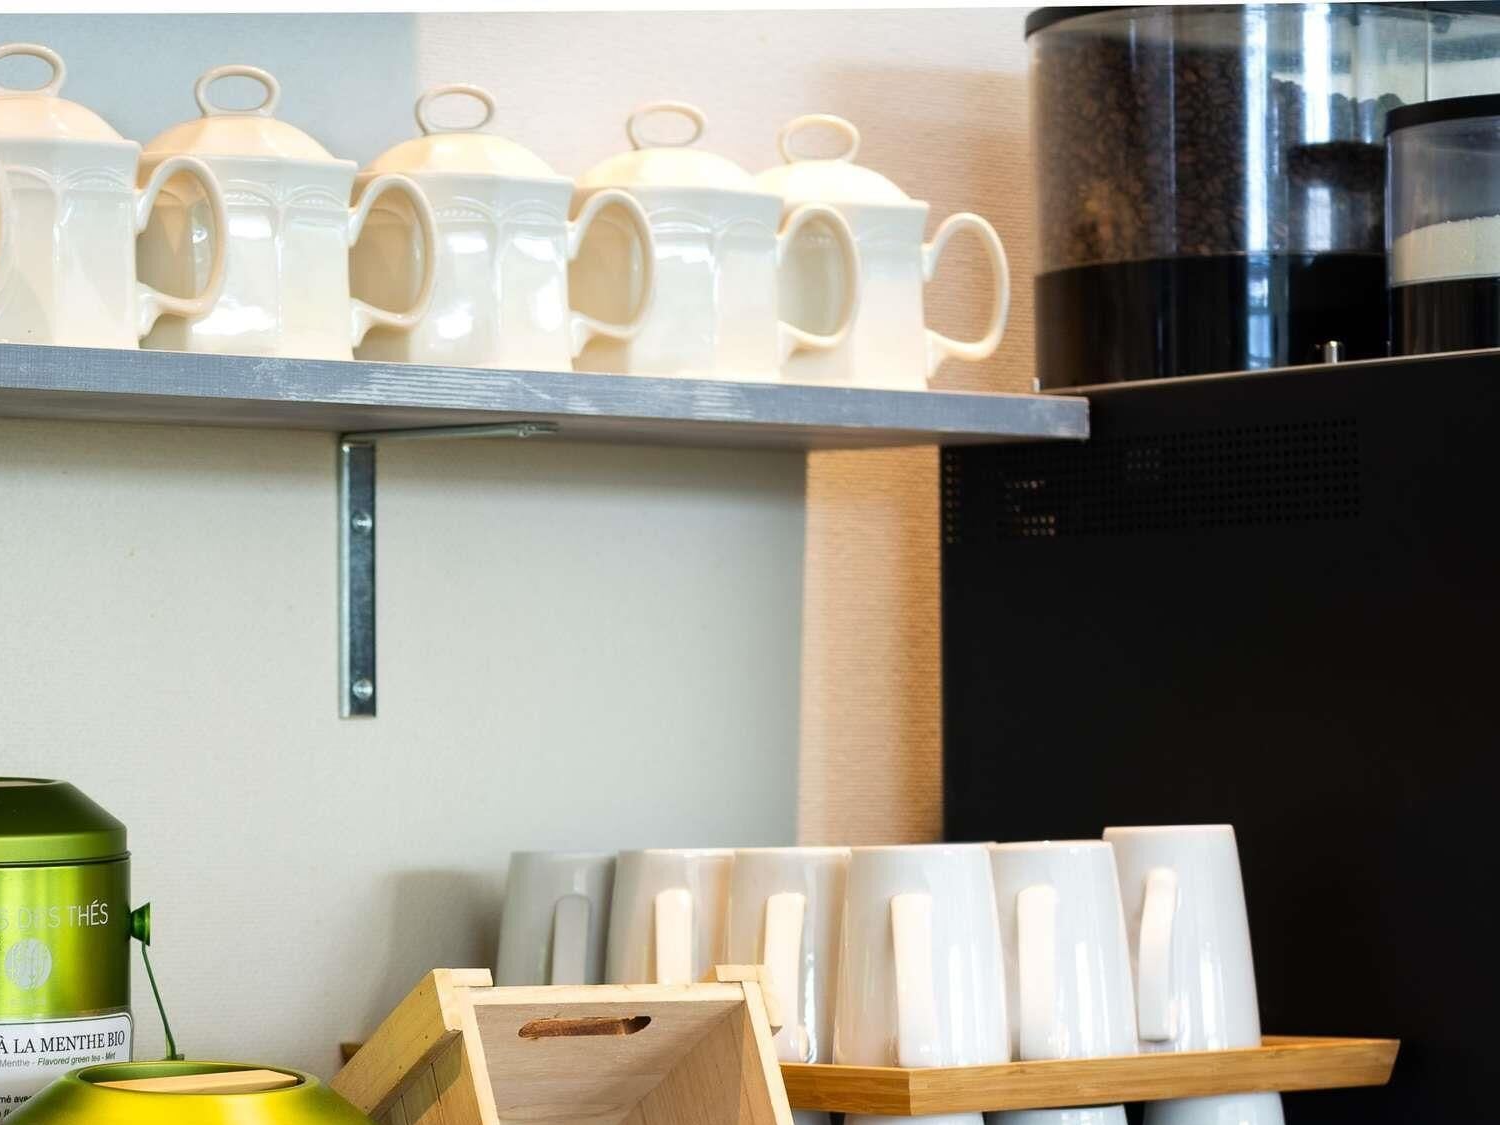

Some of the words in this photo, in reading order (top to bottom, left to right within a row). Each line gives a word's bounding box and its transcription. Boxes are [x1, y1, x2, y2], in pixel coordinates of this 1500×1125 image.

[17, 906, 60, 930] DES
[68, 899, 109, 927] THÉS
[13, 1037, 35, 1054] LA
[40, 1033, 105, 1053] MENTHE
[107, 1030, 125, 1047] BIO
[0, 1058, 30, 1068] Menthe
[38, 1055, 69, 1066] Flavored
[70, 1056, 90, 1066] green
[91, 1054, 101, 1063] tea
